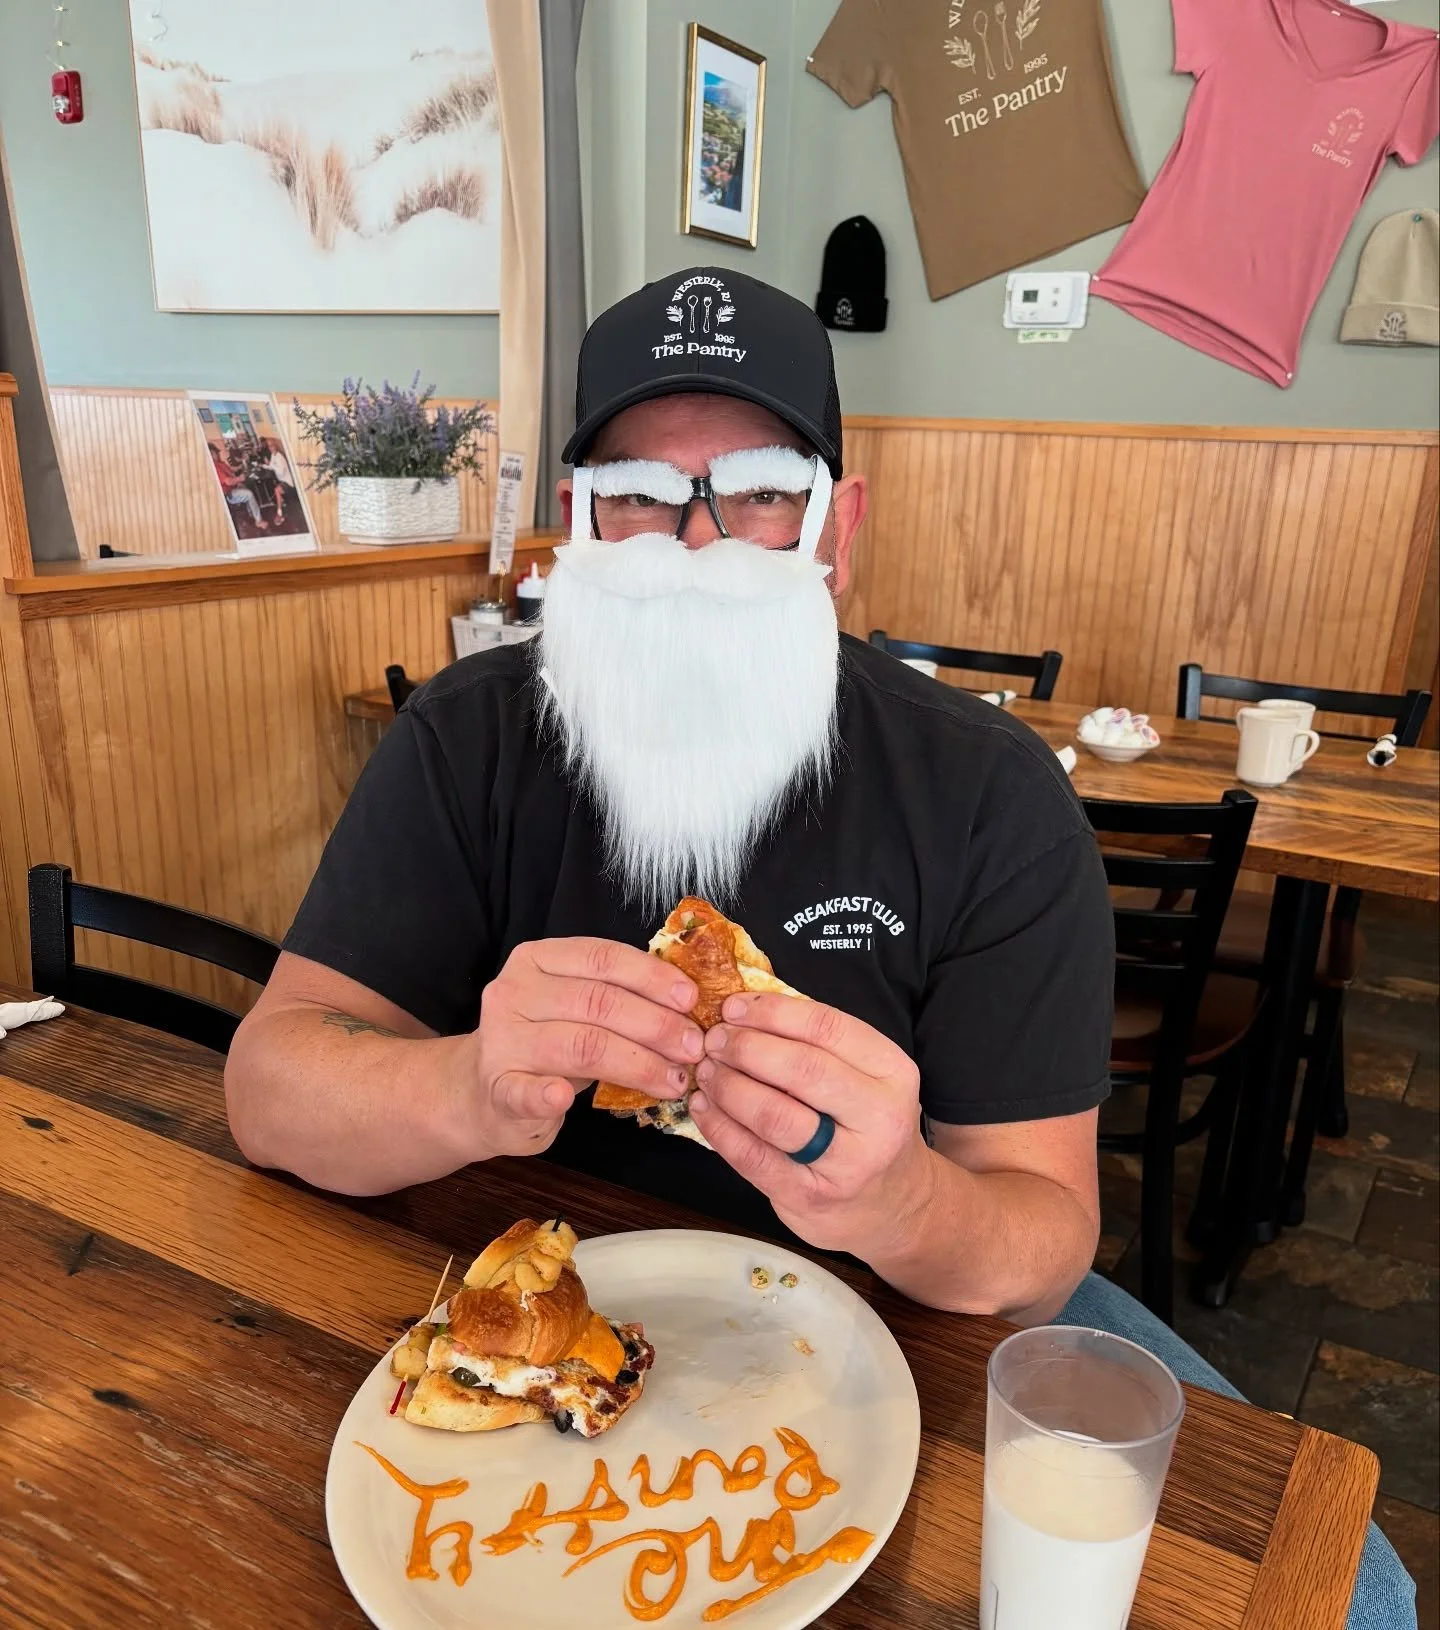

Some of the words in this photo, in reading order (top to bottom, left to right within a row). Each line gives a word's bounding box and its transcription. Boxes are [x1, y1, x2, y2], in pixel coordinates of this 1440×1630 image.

[958, 88, 982, 105] EST.
[1024, 53, 1048, 74] 1995
[945, 107, 990, 137] The
[992, 66, 1067, 118] Pantry
[1326, 149, 1352, 168] Pantry
[672, 276, 725, 302] WESTERLY,
[715, 333, 735, 344] 1995
[652, 344, 684, 359] The
[687, 342, 746, 362] Pantry
[783, 896, 873, 936] BREAKFAST
[872, 901, 905, 936] CLUB
[823, 924, 843, 935] EST.
[846, 923, 873, 934] 1995
[810, 938, 862, 950] WESTERLY
[352, 1426, 840, 1586] Pantry
